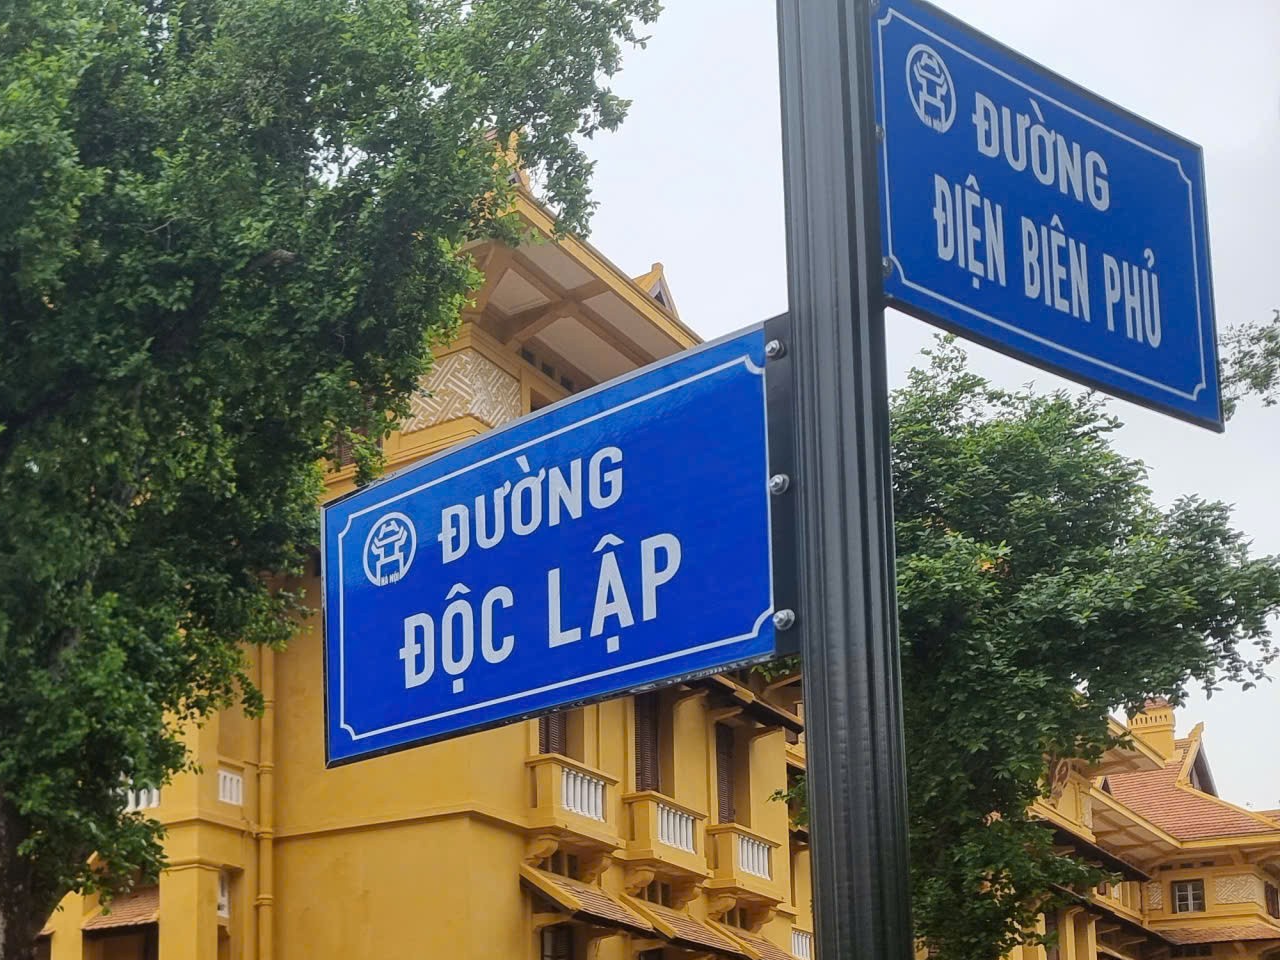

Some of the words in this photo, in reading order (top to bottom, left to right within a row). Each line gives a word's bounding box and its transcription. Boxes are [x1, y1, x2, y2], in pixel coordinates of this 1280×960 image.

[972, 92, 1110, 211] ĐƯỜNG
[933, 174, 1006, 289] ĐIỆN
[1021, 214, 1090, 322] BIÊN
[1103, 248, 1162, 349] PHỦ
[438, 446, 623, 564] ĐƯỜNG
[400, 583, 515, 694] ĐỘC
[548, 533, 682, 654] LẬP
